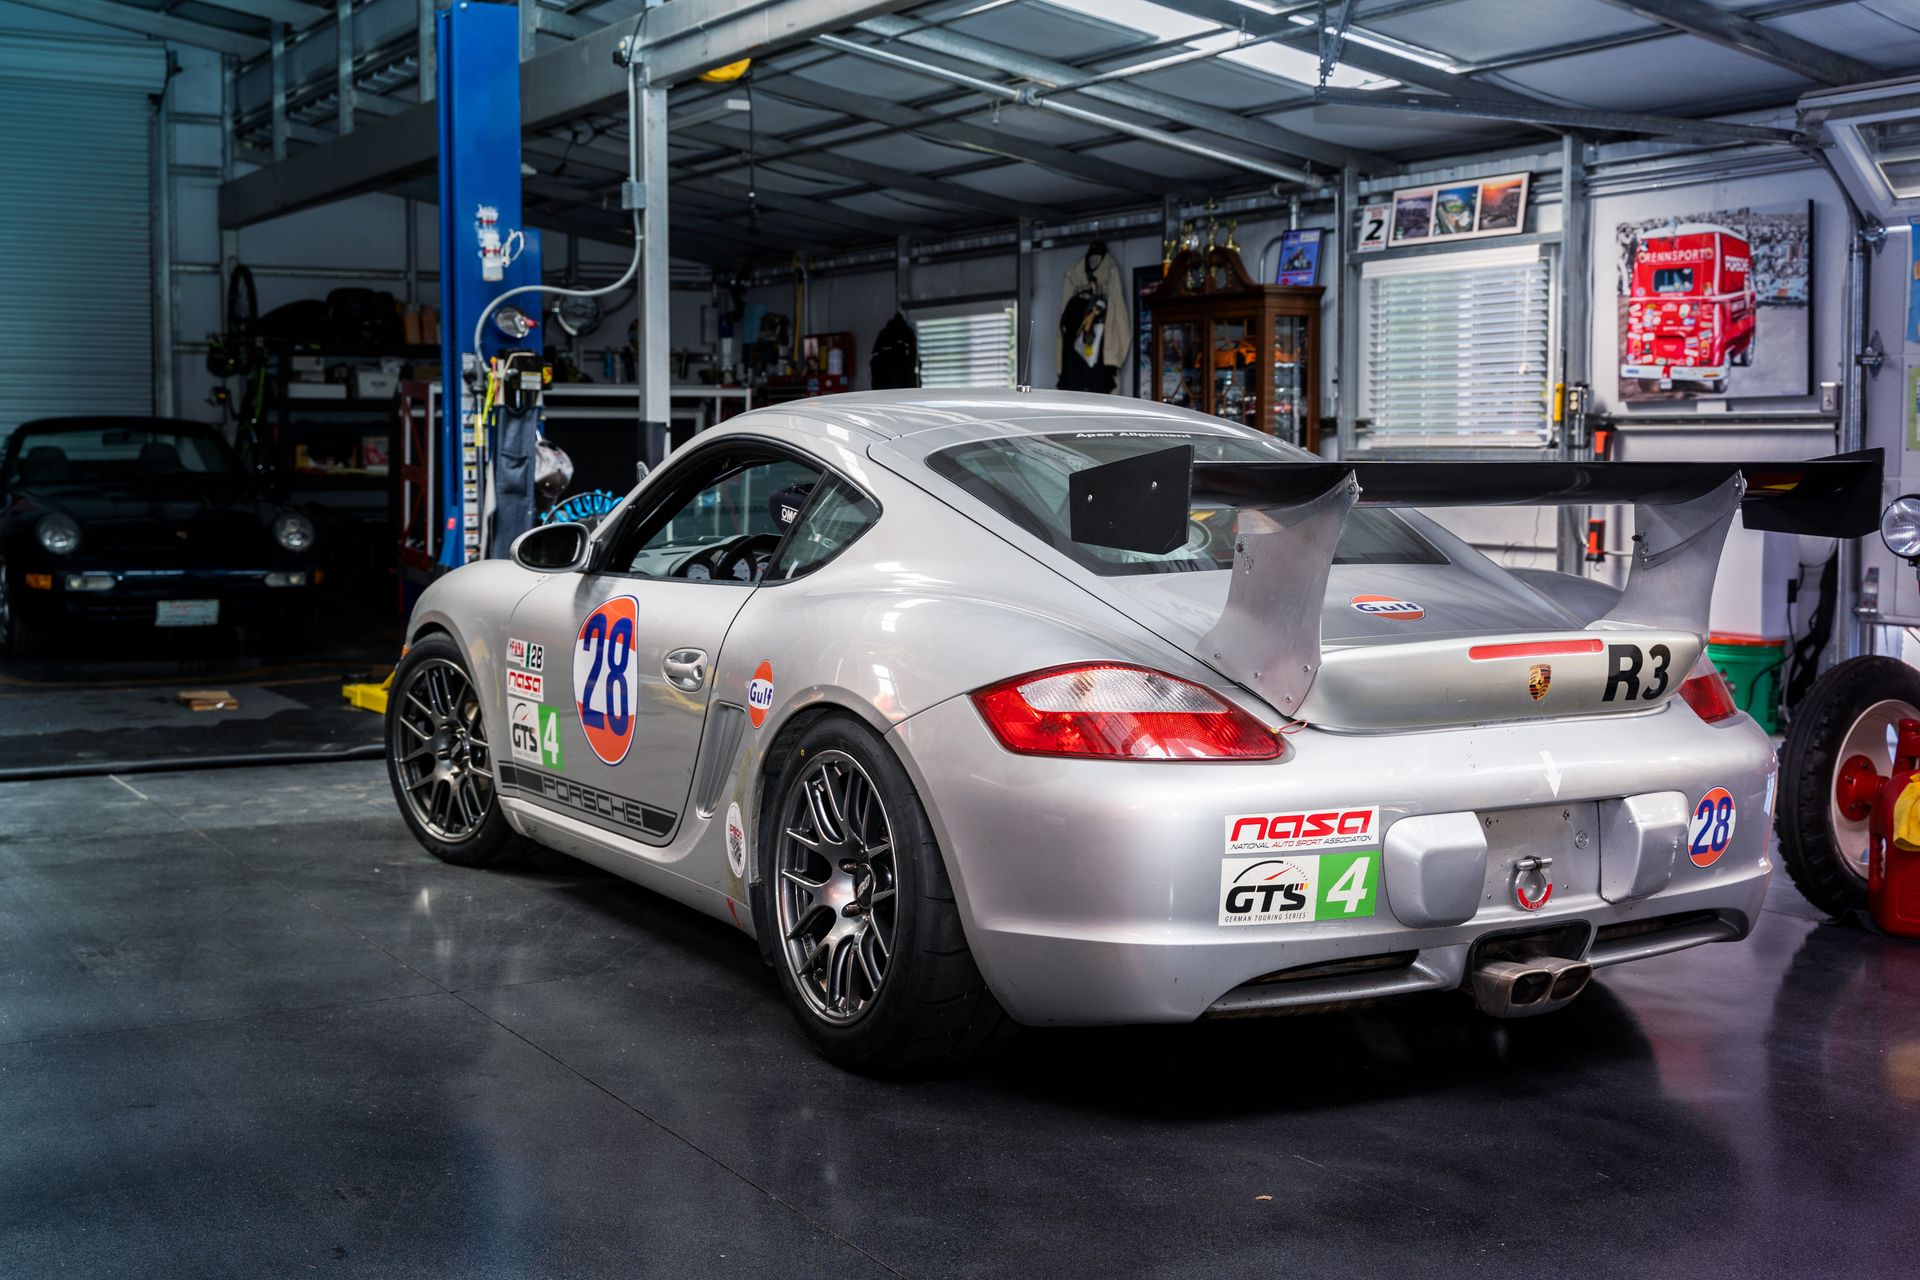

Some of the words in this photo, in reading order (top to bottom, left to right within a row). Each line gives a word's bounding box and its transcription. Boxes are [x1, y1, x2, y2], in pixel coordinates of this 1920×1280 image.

[1365, 219, 1384, 241] 2
[1647, 248, 1705, 262] RENNSPORT
[1356, 603, 1418, 612] Gulf
[531, 645, 543, 669] 2B
[583, 612, 633, 736] 28
[1602, 644, 1671, 702] R3
[750, 682, 773, 706] Gulf
[513, 723, 538, 753] GTS
[544, 712, 559, 765] 4
[543, 776, 642, 827] PORSCHE
[1691, 796, 1732, 855] 28
[1230, 841, 1270, 850] NATIONAL
[1272, 840, 1293, 848] AUTO
[1295, 838, 1323, 847] SPORT
[1323, 835, 1373, 845] ASSOCIATION
[1225, 883, 1307, 914] GTS
[1325, 856, 1371, 913] 4
[1225, 915, 1252, 923] GERMAN
[1255, 913, 1283, 922] TOURING
[1285, 912, 1306, 920] SERIES
